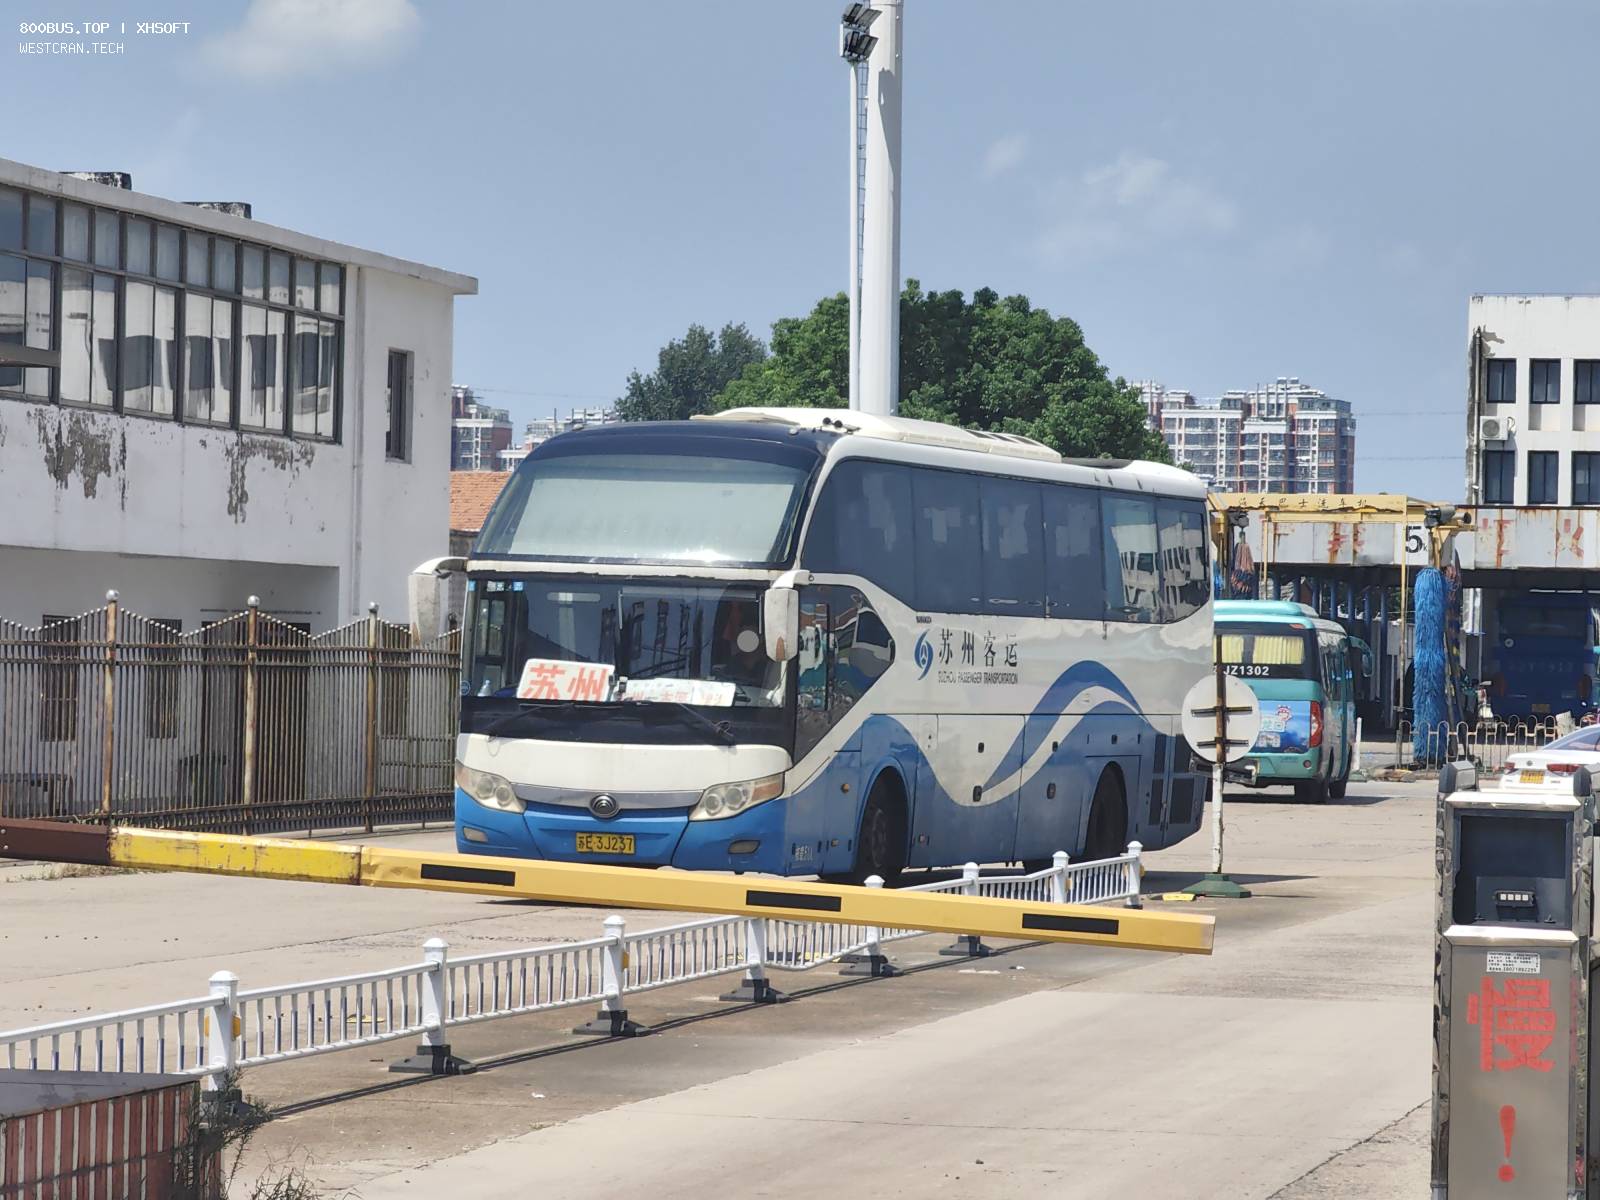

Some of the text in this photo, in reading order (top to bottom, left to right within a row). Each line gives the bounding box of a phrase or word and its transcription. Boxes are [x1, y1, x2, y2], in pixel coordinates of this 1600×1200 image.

[939, 628, 1018, 667] 苏州客运
[522, 663, 609, 701] 苏州
